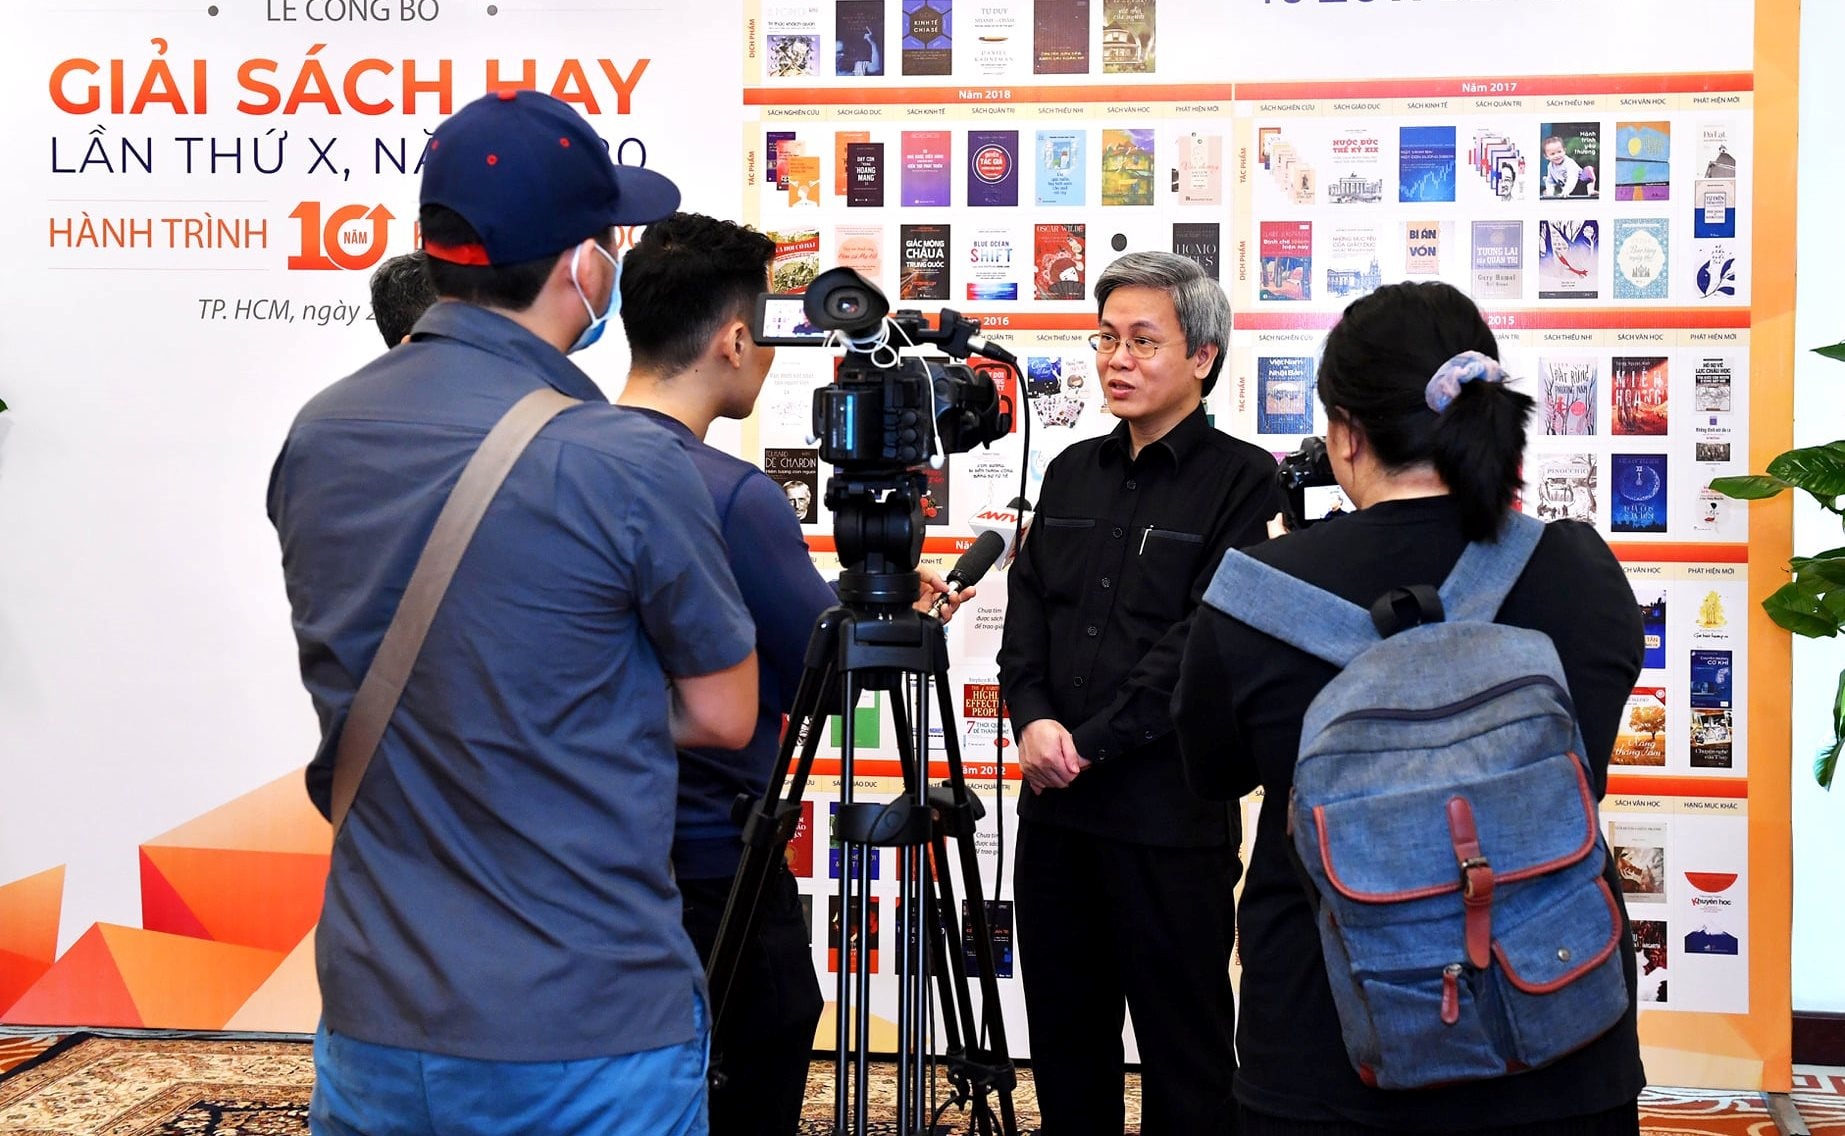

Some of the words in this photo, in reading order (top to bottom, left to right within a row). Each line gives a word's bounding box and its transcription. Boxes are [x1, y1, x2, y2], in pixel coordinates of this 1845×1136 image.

[49, 37, 207, 115] GIẢI
[236, 43, 452, 116] SÁCH
[486, 58, 651, 115] HAY
[1462, 83, 1487, 93] Năm
[1490, 83, 1517, 93] 2017
[958, 90, 982, 100] Năm
[985, 90, 1011, 100] 2018
[1260, 103, 1276, 111] SÁCH
[1277, 103, 1299, 111] NGHIÊN
[1301, 103, 1315, 111] CỨU
[1334, 102, 1349, 110] SÁCH
[1351, 102, 1365, 110] GIÁO
[1407, 101, 1423, 109] SÁCH
[1425, 101, 1439, 109] KINH
[1440, 101, 1448, 109] TẾ
[1546, 99, 1562, 107] SÁCH
[1564, 99, 1581, 107] THIẾU
[1583, 99, 1595, 107] NHI
[767, 108, 783, 116] SÁCH
[784, 108, 805, 116] NGHIÊN
[806, 108, 819, 116] CỨU
[907, 107, 922, 115] SÁCH
[924, 107, 937, 115] KINH
[938, 107, 945, 115] TẾ
[52, 124, 152, 173] LẦN
[175, 128, 288, 174] THỨ
[308, 137, 350, 181] X,
[50, 212, 151, 248] HÀNH
[162, 212, 267, 249] TRÌNH
[1036, 224, 1060, 233] OSCAR
[1061, 224, 1084, 233] WILDE
[343, 231, 368, 246] NĂM
[906, 240, 922, 248] GIẤC
[923, 240, 945, 248] MỘNG
[970, 248, 1013, 263] SHIFT
[1504, 247, 1518, 255] LAI
[199, 298, 226, 320] TP.
[234, 299, 294, 323] HCM,
[303, 300, 360, 326] ngày
[983, 317, 1009, 326] 2016
[1488, 315, 1515, 325] 2015
[1544, 333, 1560, 341] SÁCH
[1561, 333, 1579, 341] THIẾU
[1581, 333, 1592, 341] NHI
[1617, 333, 1634, 341] SÁCH
[1635, 333, 1649, 341] VĂN
[1650, 333, 1664, 341] HỌC
[1269, 358, 1286, 367] Việt
[1286, 358, 1304, 367] Nam
[1268, 369, 1287, 377] Nhật
[1287, 369, 1304, 377] Bản
[1615, 388, 1663, 407] HOANG
[766, 458, 776, 468] DE
[780, 458, 816, 468] CHARDIN
[920, 557, 934, 565] KINH
[935, 557, 942, 565] TẾ
[974, 623, 981, 631] để
[982, 623, 994, 631] trao
[1707, 658, 1716, 666] CƠ
[1716, 658, 1728, 666] KHÍ
[973, 691, 999, 700] HIGHL
[972, 708, 998, 717] PEOPL
[963, 766, 978, 775] ăm
[1615, 799, 1630, 807] SÁCH
[1631, 799, 1645, 807] VĂN
[1647, 799, 1661, 807] HỌC
[1721, 801, 1738, 810] KHÁC
